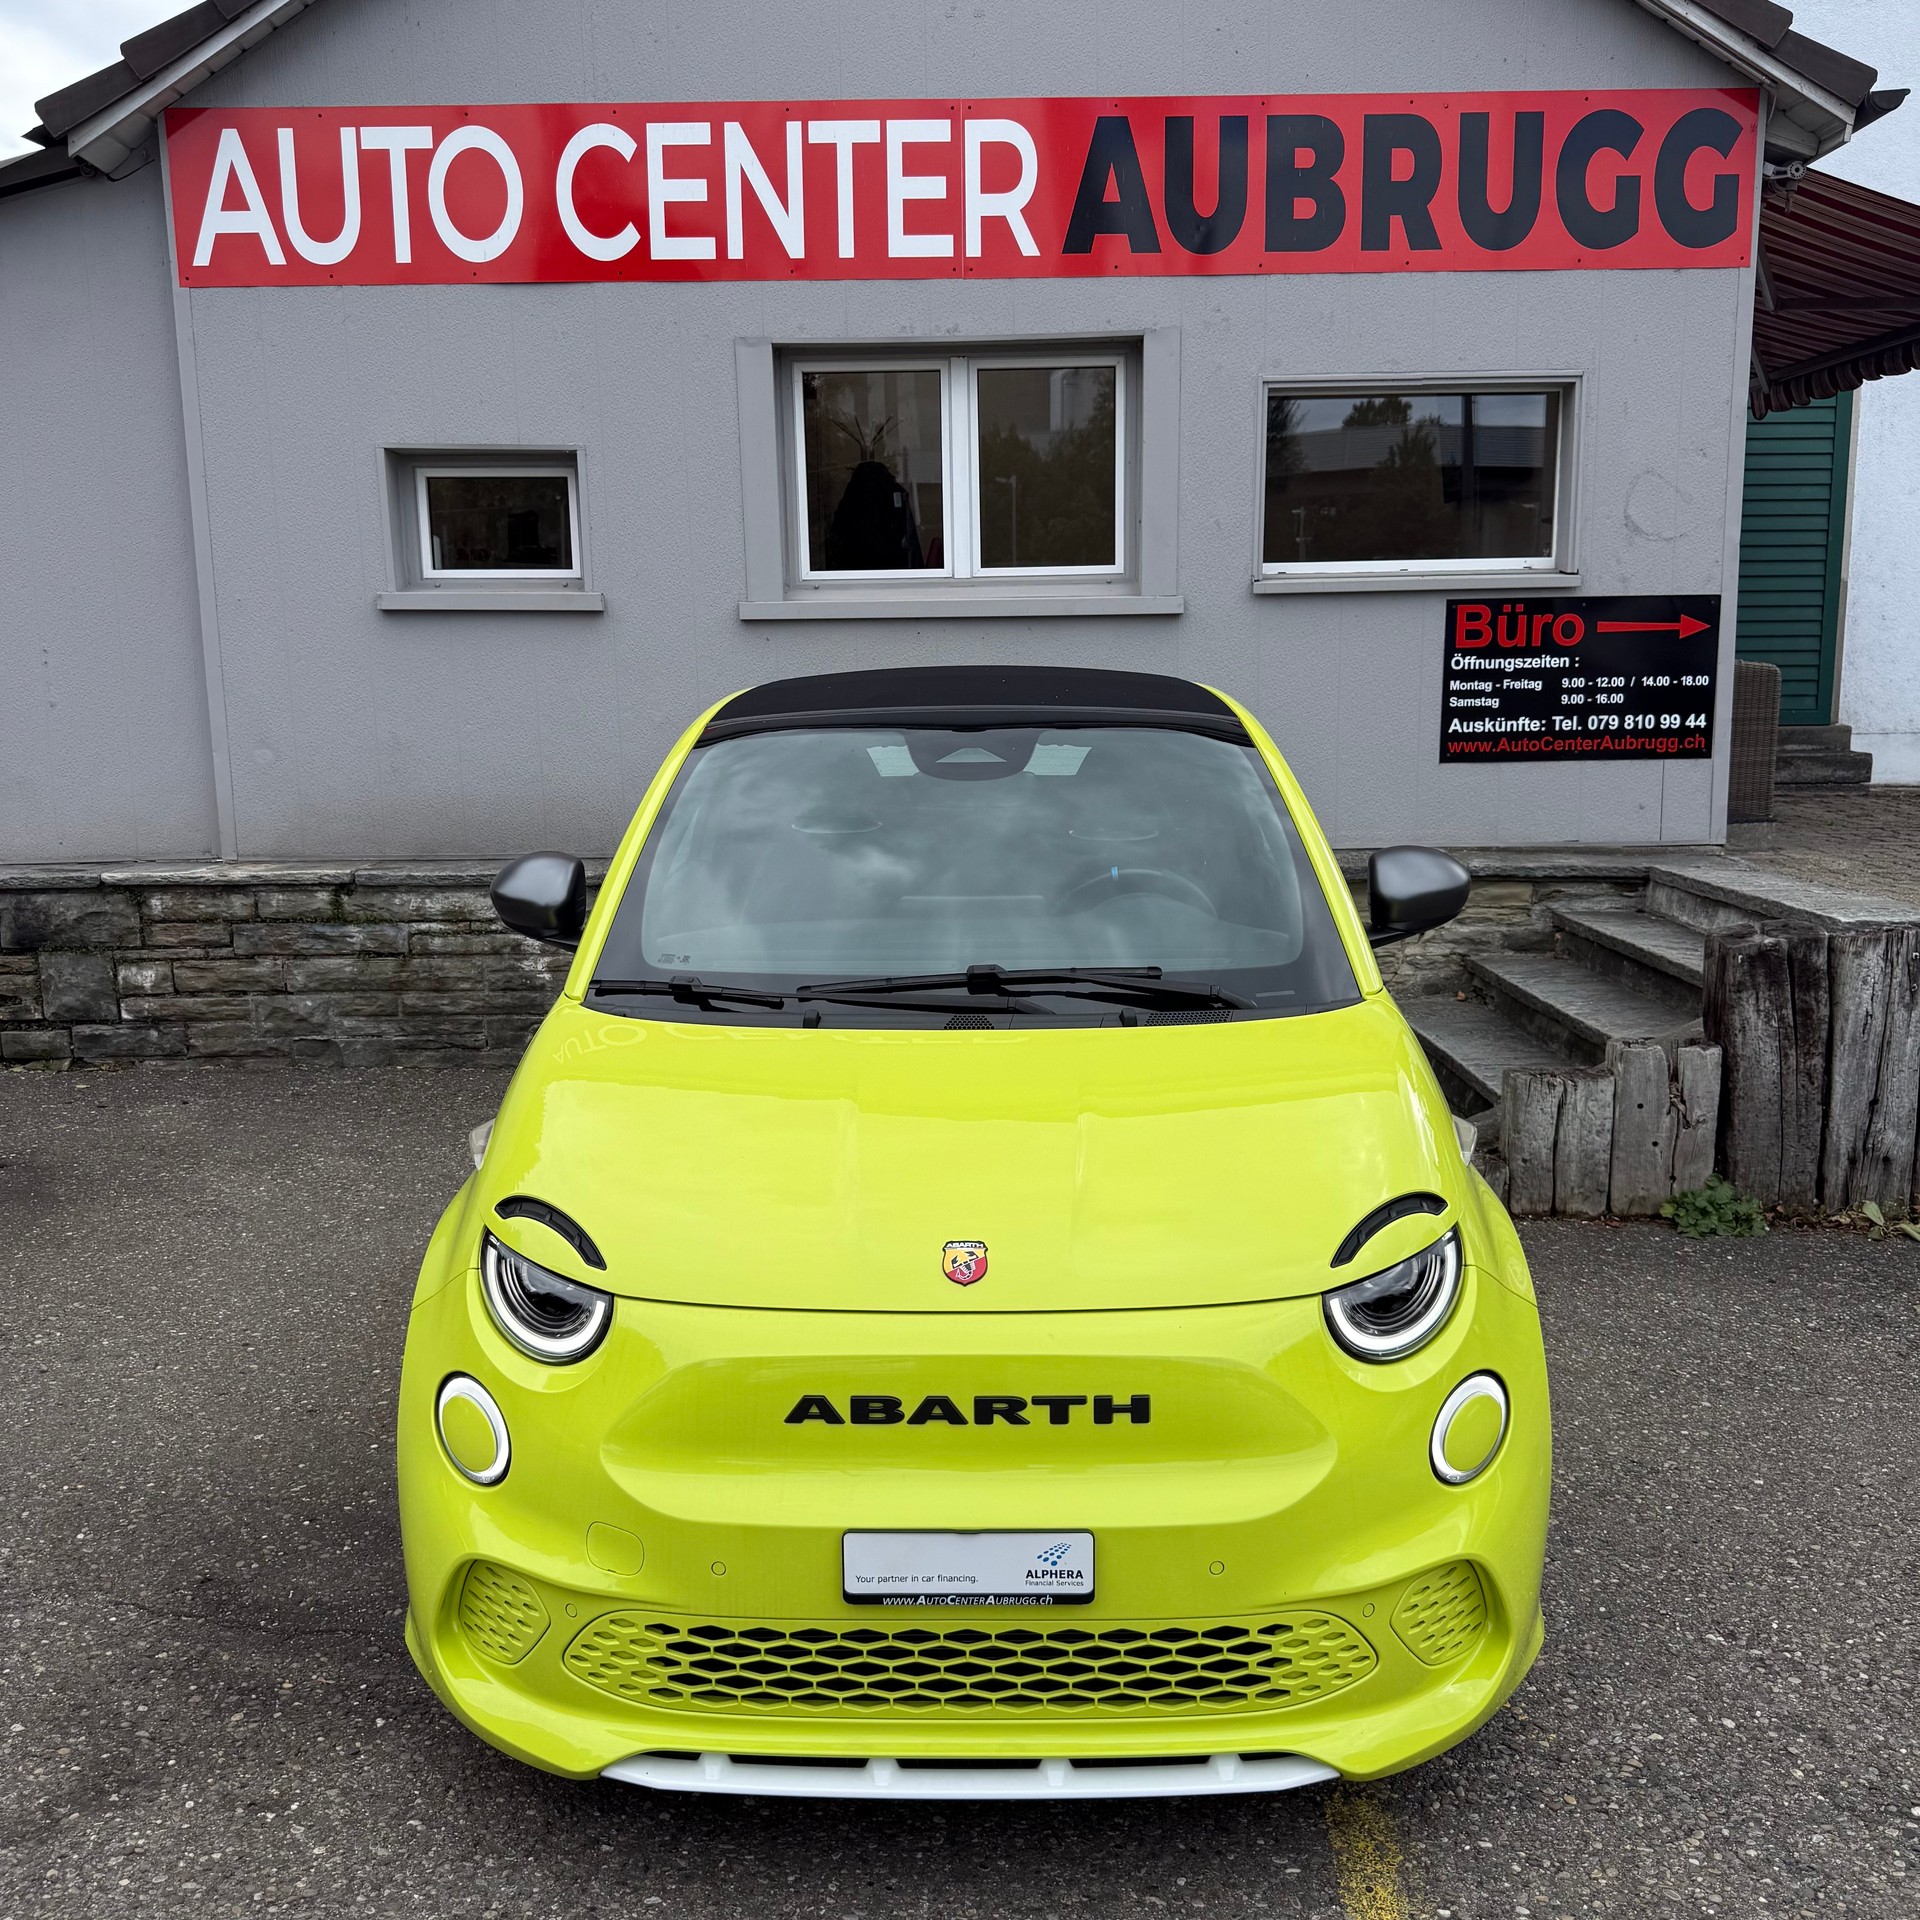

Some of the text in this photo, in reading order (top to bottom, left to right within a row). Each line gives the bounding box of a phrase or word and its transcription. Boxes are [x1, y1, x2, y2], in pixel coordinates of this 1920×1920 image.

[192, 107, 1744, 266] AUTO CENTER AUBRUGG
[1455, 603, 1585, 649] Büro
[1451, 653, 1570, 672] Öffnungszeiten
[1449, 680, 1493, 692] Montag
[1503, 679, 1543, 691] Freitag
[1561, 677, 1585, 688] 9.00
[1595, 677, 1625, 688] 12.00
[1641, 676, 1670, 687] 14.00
[1680, 675, 1710, 686] 18.00
[1449, 696, 1500, 709] Samstag
[1561, 694, 1585, 705] 9.00
[1595, 693, 1625, 704] 16.00
[1448, 713, 1707, 733] Auskünfte: Tel. 079 810 99 44
[1448, 734, 1706, 753] www.AutoCenterAubrugg.ch
[784, 1395, 1151, 1425] ABARTH
[855, 1575, 875, 1583] Your
[877, 1575, 908, 1584] partner
[911, 1574, 919, 1582] in
[938, 1574, 979, 1584] financing.
[1025, 1569, 1084, 1579] ALPHERA
